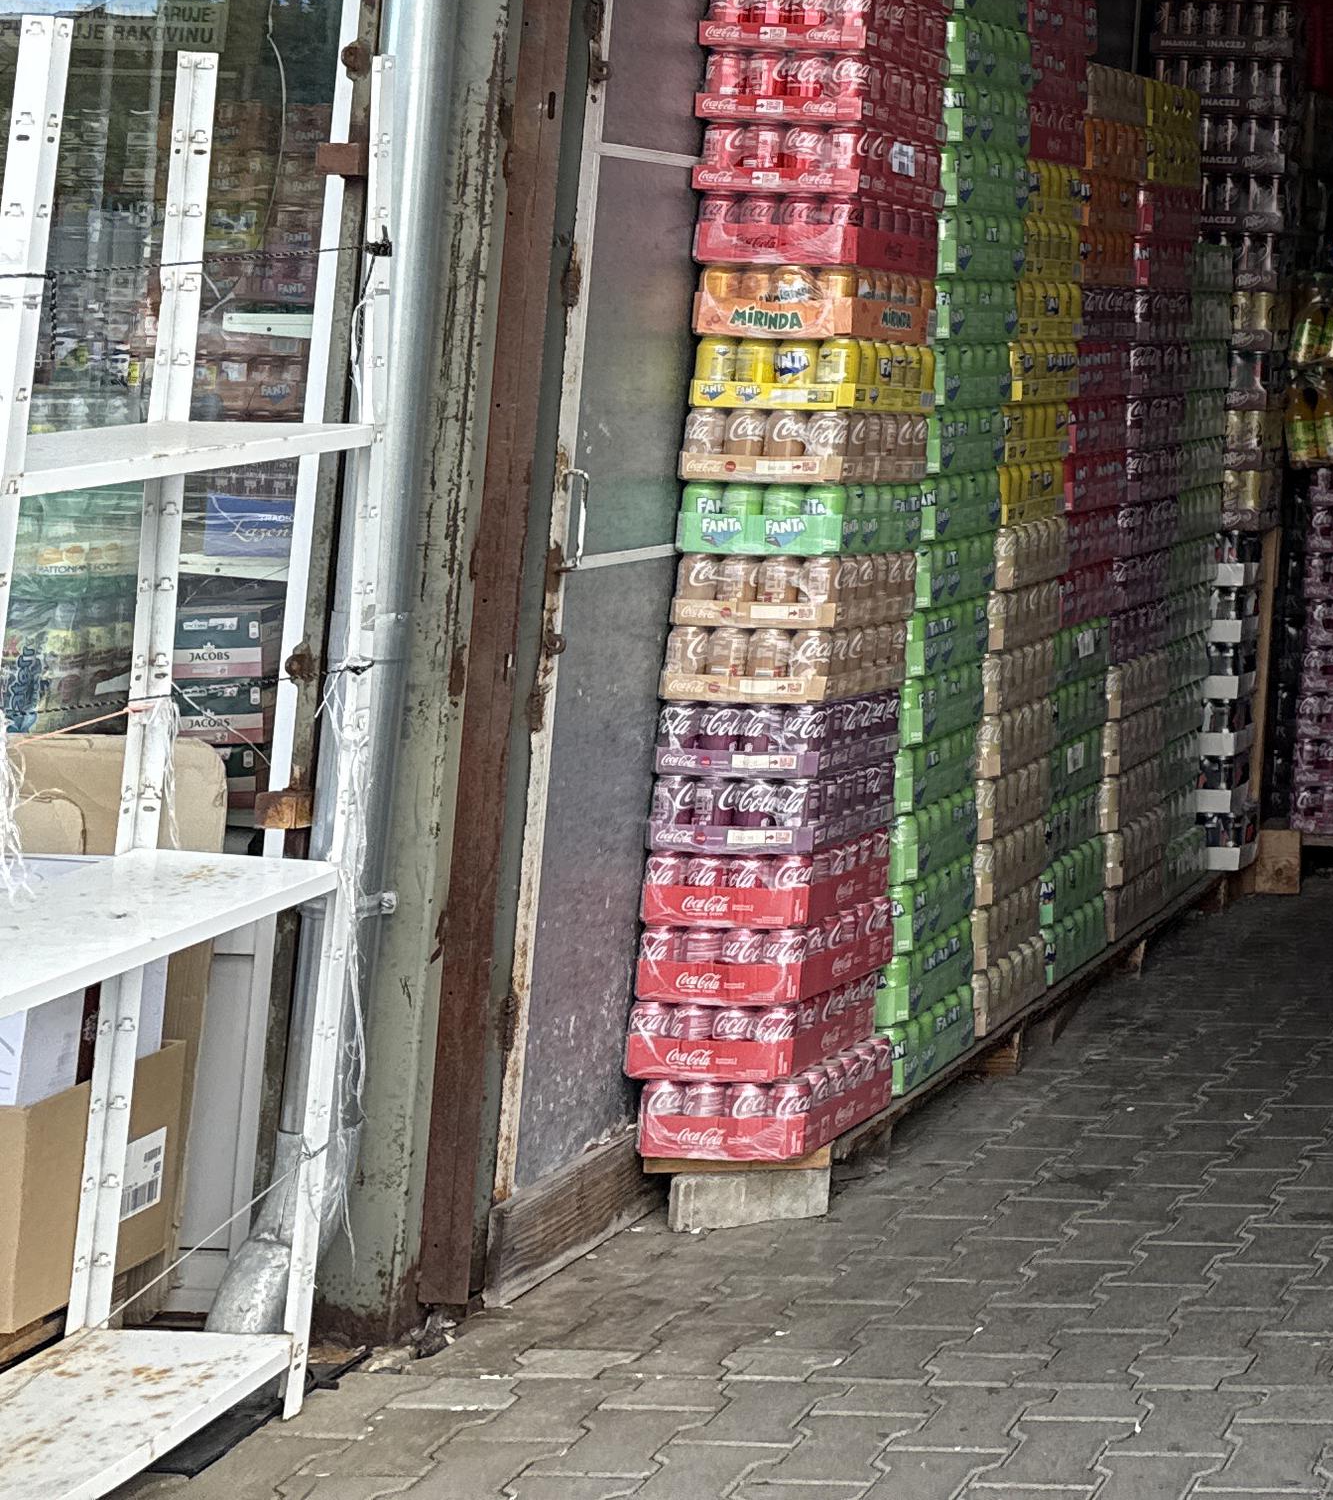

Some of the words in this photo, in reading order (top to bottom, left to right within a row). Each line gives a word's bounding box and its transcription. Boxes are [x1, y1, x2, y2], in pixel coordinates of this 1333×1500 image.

[701, 517, 742, 533] FANTA
[765, 517, 806, 533] FANTA
[189, 651, 230, 661] JACOBS
